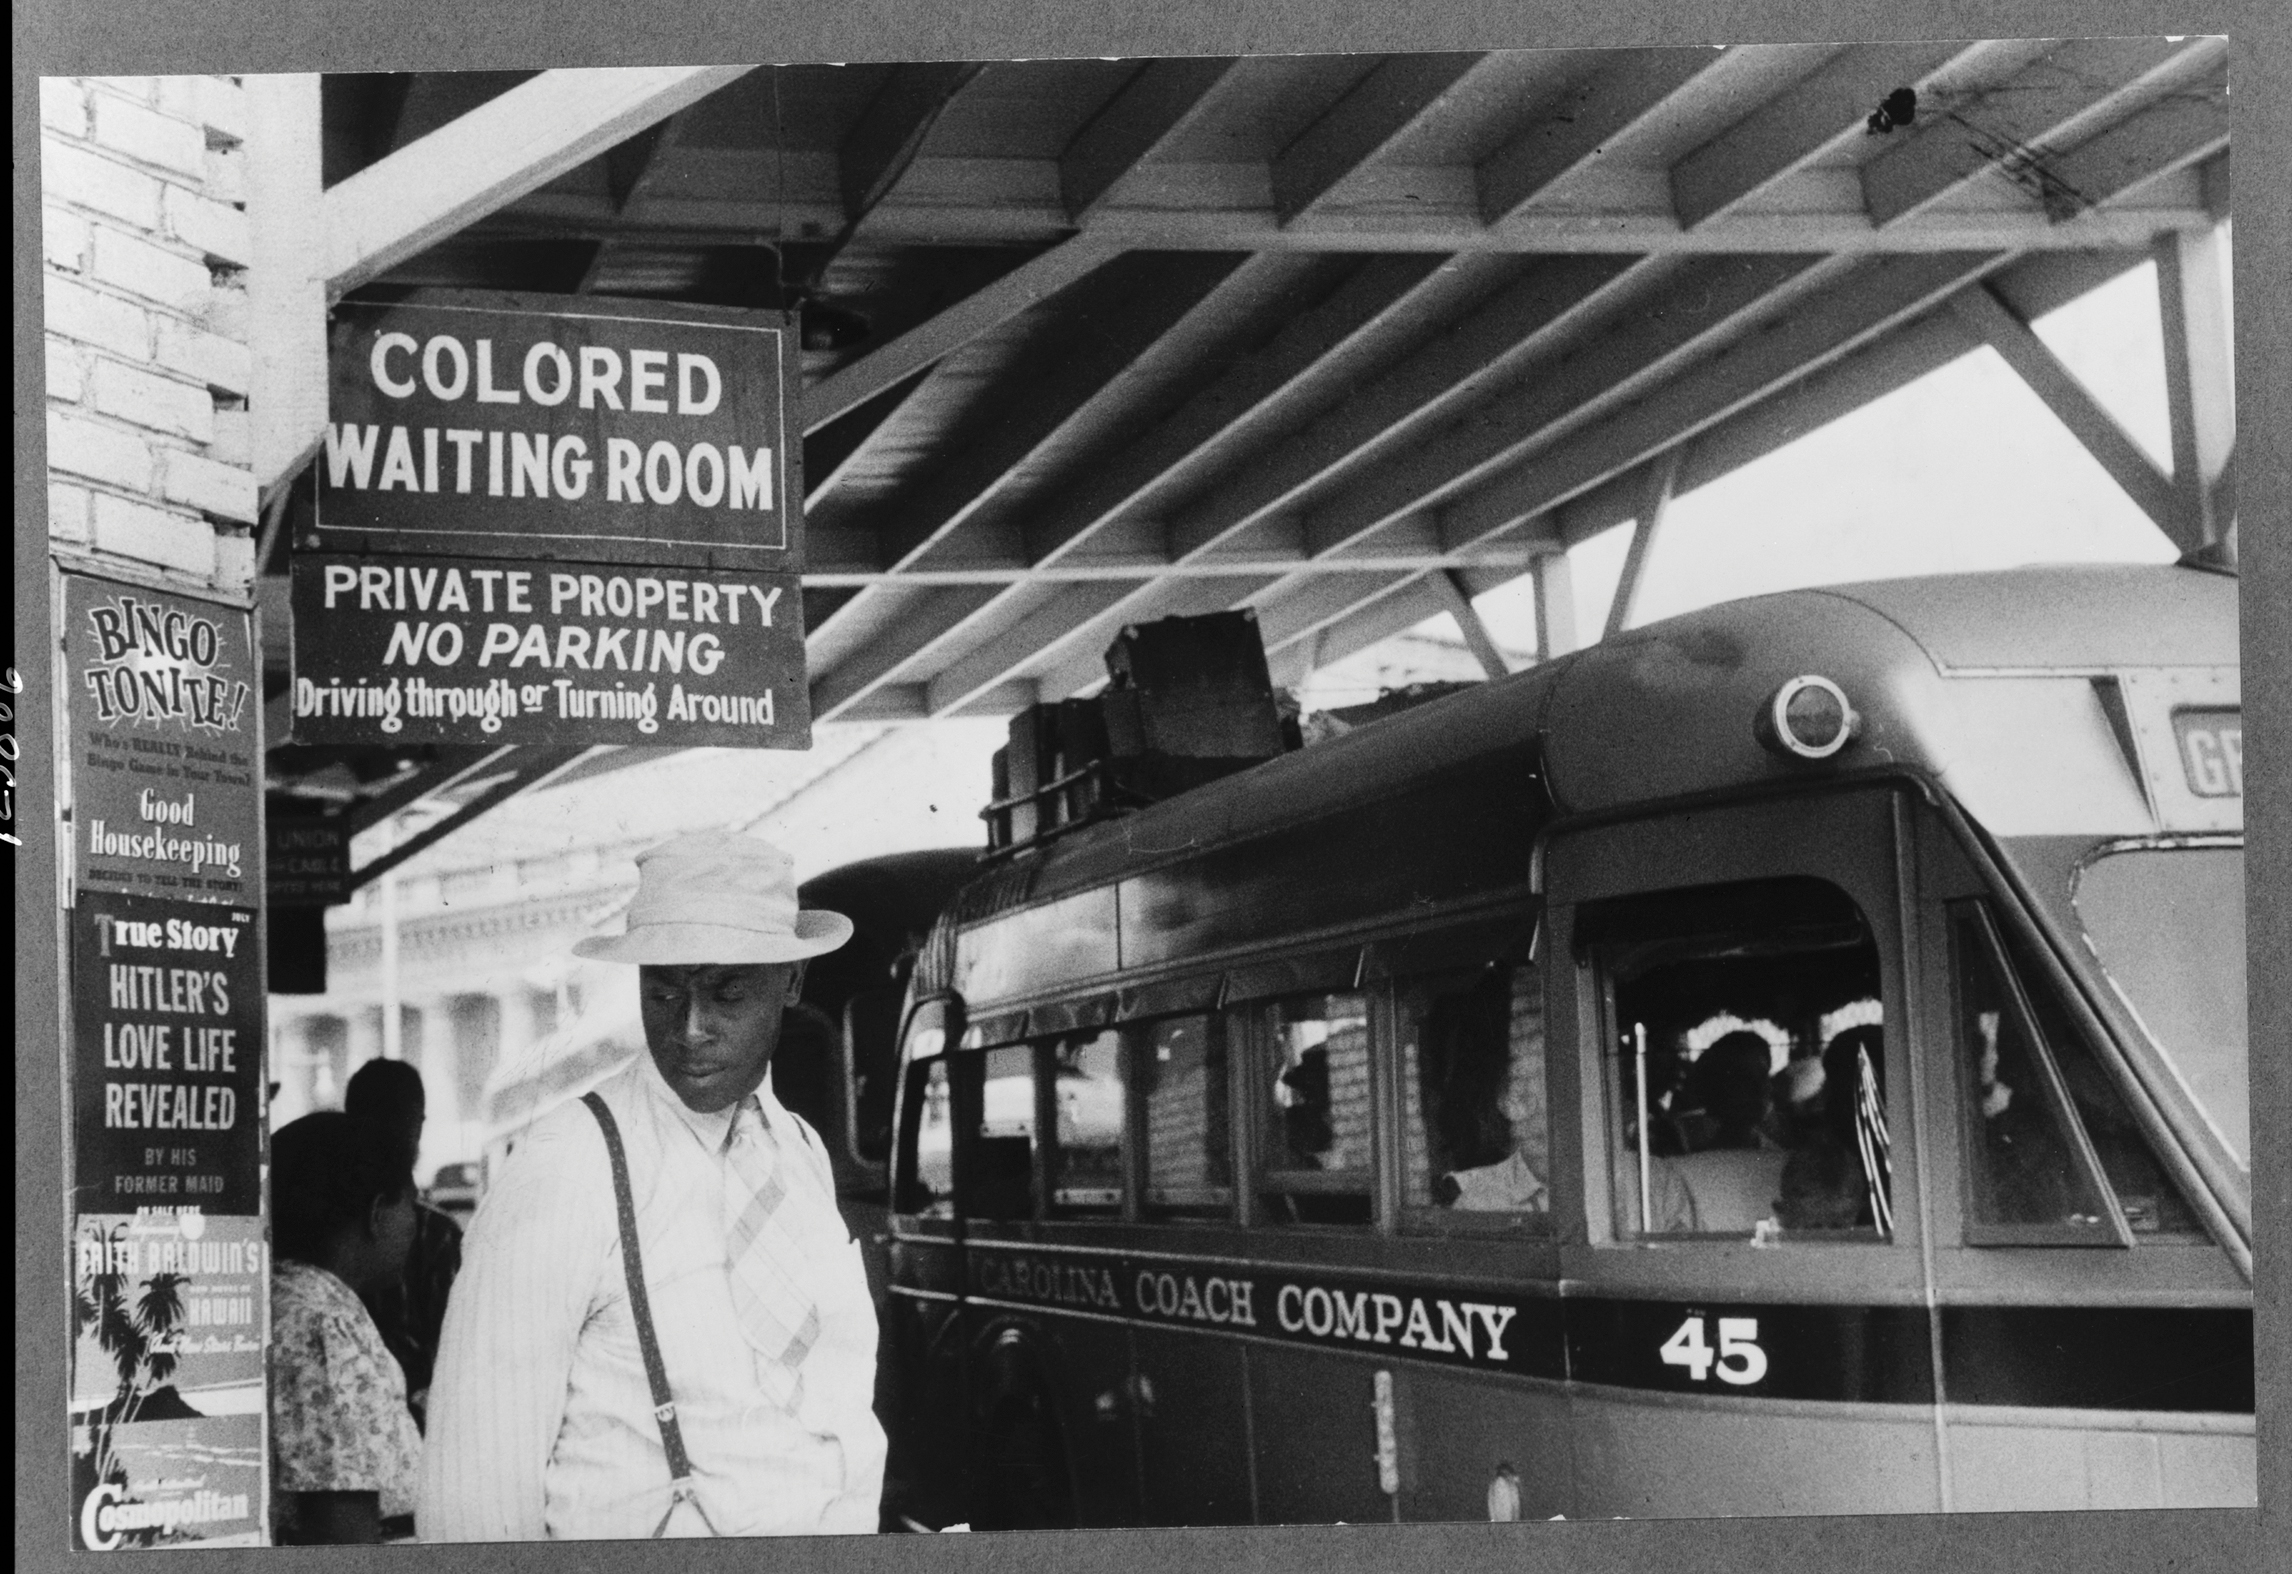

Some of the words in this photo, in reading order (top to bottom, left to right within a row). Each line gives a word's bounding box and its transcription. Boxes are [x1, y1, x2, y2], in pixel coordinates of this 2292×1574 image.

[370, 332, 721, 415] COLORED
[325, 422, 593, 501] WAITING
[607, 437, 773, 511] ROOM
[324, 566, 533, 613] PRIVATE
[550, 573, 782, 626] PROPERTY
[89, 597, 218, 667] BINGO
[382, 621, 464, 666] NO
[477, 623, 725, 675] PARKING
[85, 666, 248, 730] TONITE!
[296, 677, 402, 733] Driving
[405, 678, 517, 733] through
[521, 683, 549, 711] or
[553, 679, 658, 733] Turning
[668, 684, 773, 725] Around
[87, 752, 125, 772] Bingo
[129, 758, 163, 775] Game
[182, 765, 210, 781] Your
[141, 788, 195, 826] Good
[90, 819, 241, 878] Housekeeping
[94, 913, 162, 957] True
[166, 919, 239, 958] Story
[231, 911, 250, 923] JULY
[110, 964, 229, 1015] HITLER'S
[104, 1023, 171, 1069] LOVE
[183, 1027, 236, 1072] LIFE
[105, 1083, 236, 1130] REVEALED
[145, 1148, 163, 1166] BY
[171, 1148, 196, 1166] HIS
[115, 1175, 178, 1194] FORMER
[185, 1176, 224, 1194] MAID
[149, 1238, 259, 1274] BALDWIN'S
[189, 1298, 252, 1325] HAWAII
[980, 1258, 1122, 1308] CAROLINA
[1135, 1272, 1257, 1327] COACH
[1276, 1284, 1517, 1363] COMPANY
[1658, 1317, 1769, 1385] 45
[81, 1483, 249, 1551] Cosmopolitan
